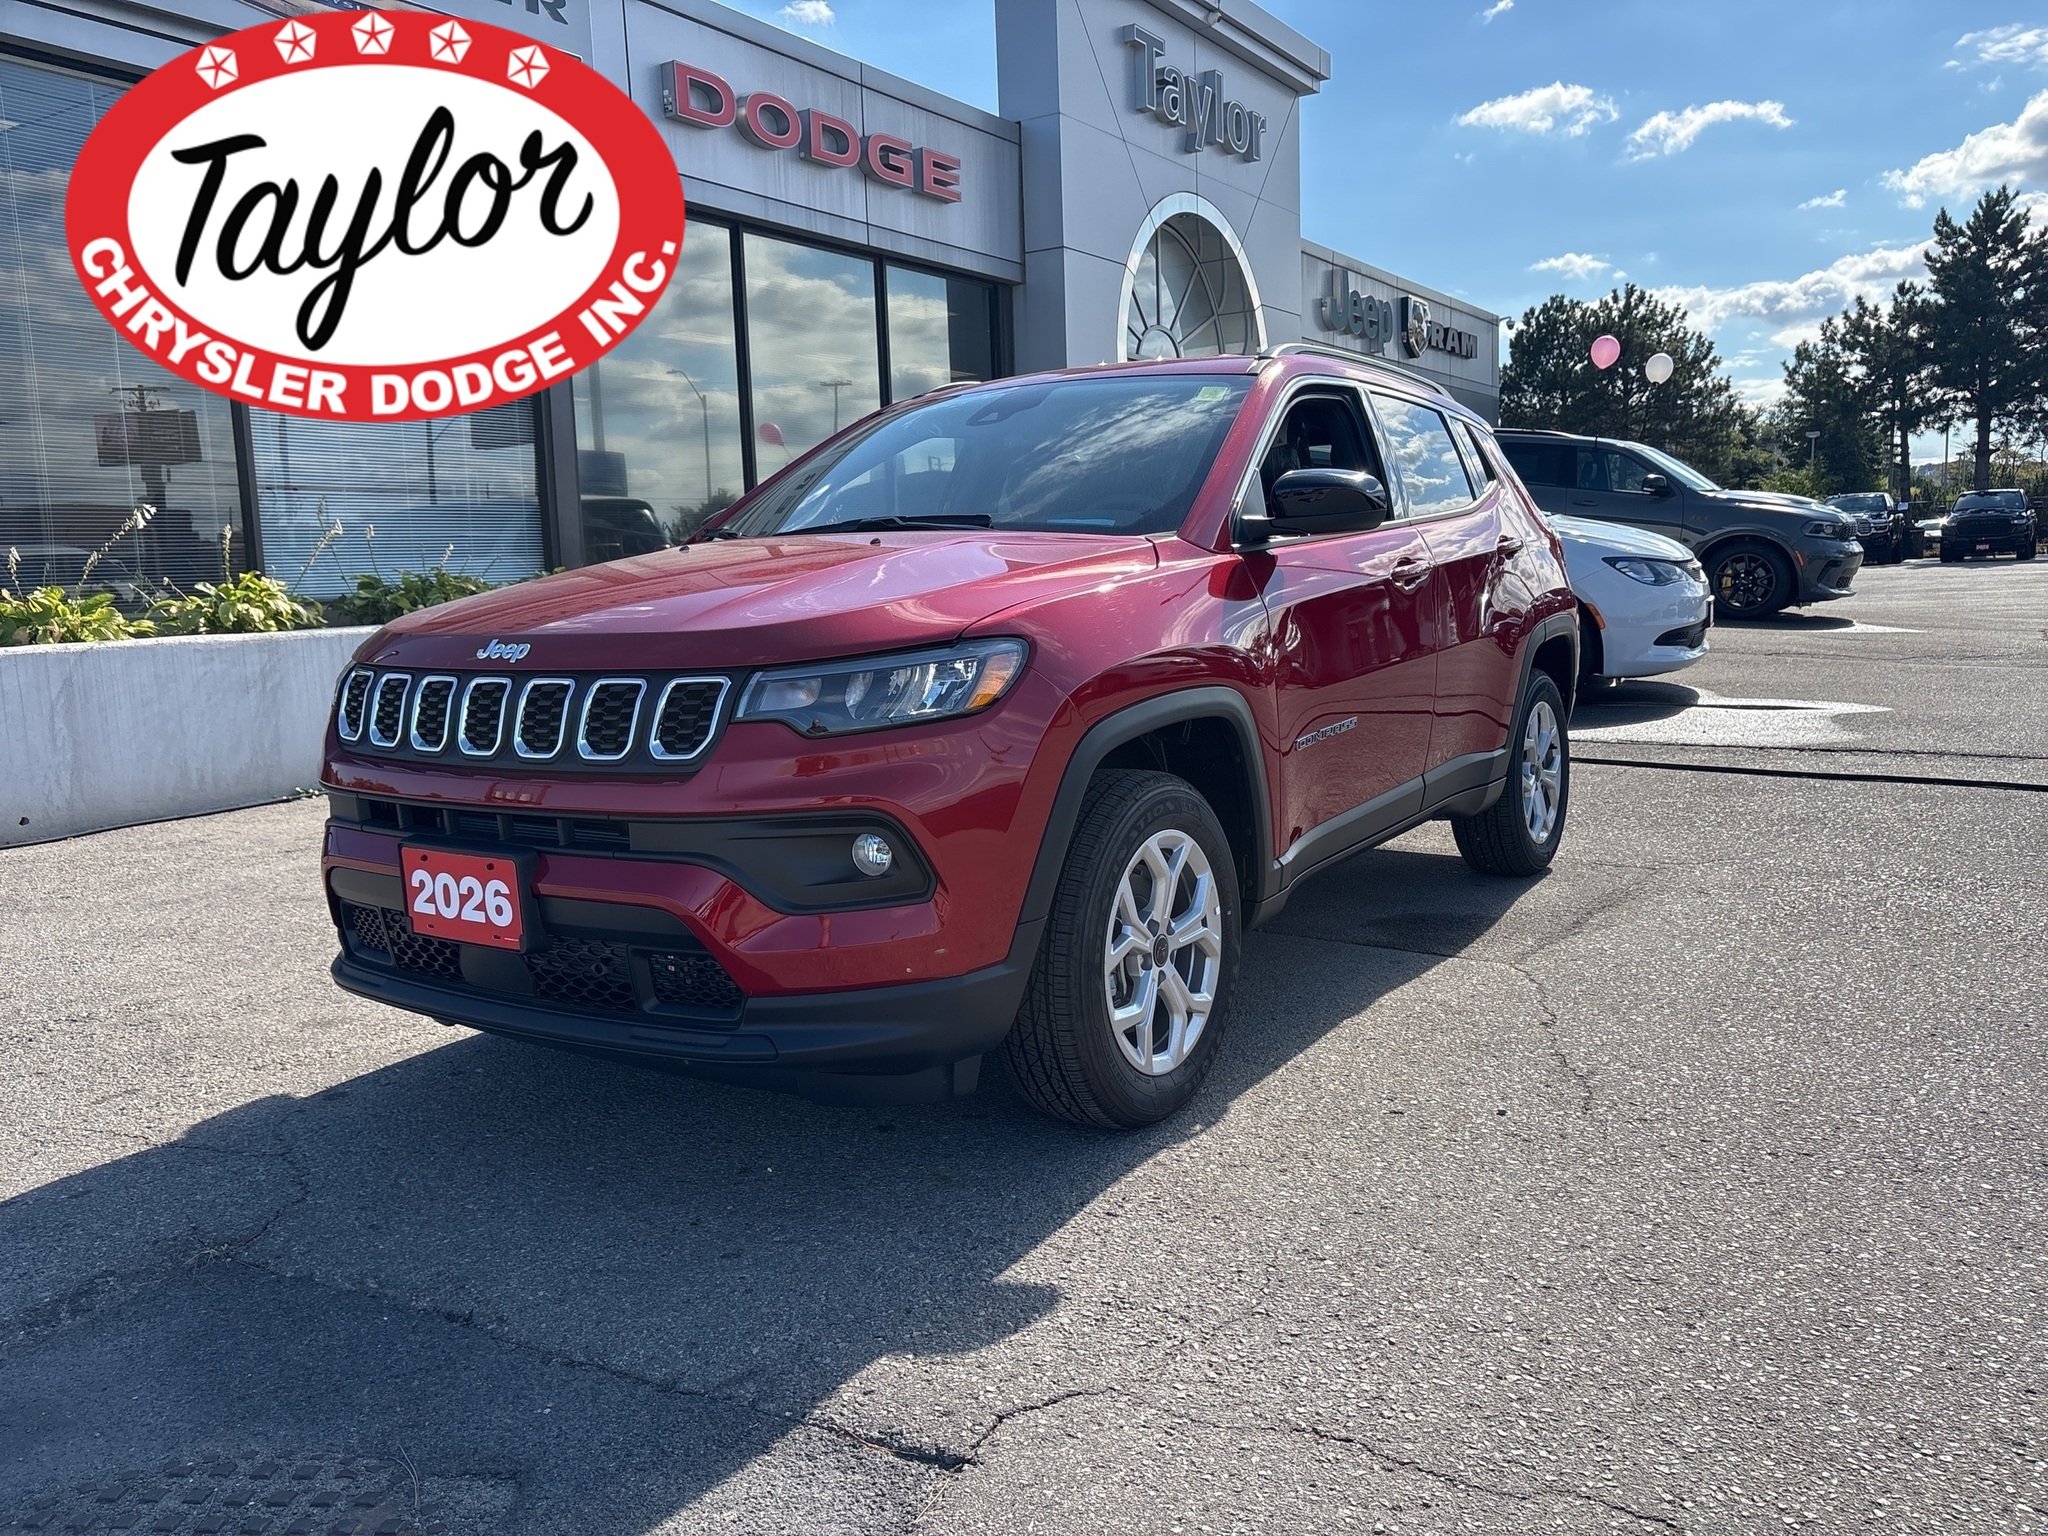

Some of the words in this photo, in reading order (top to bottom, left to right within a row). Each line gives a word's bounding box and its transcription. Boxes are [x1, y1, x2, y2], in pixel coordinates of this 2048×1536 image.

[1123, 23, 1267, 163] Taylor
[662, 59, 962, 203] DODGE
[1321, 269, 1393, 356] Jeep
[1430, 321, 1478, 359] RAM
[476, 639, 531, 663] Jeep
[1295, 715, 1358, 751] COMPASS
[411, 868, 513, 928] 2026
